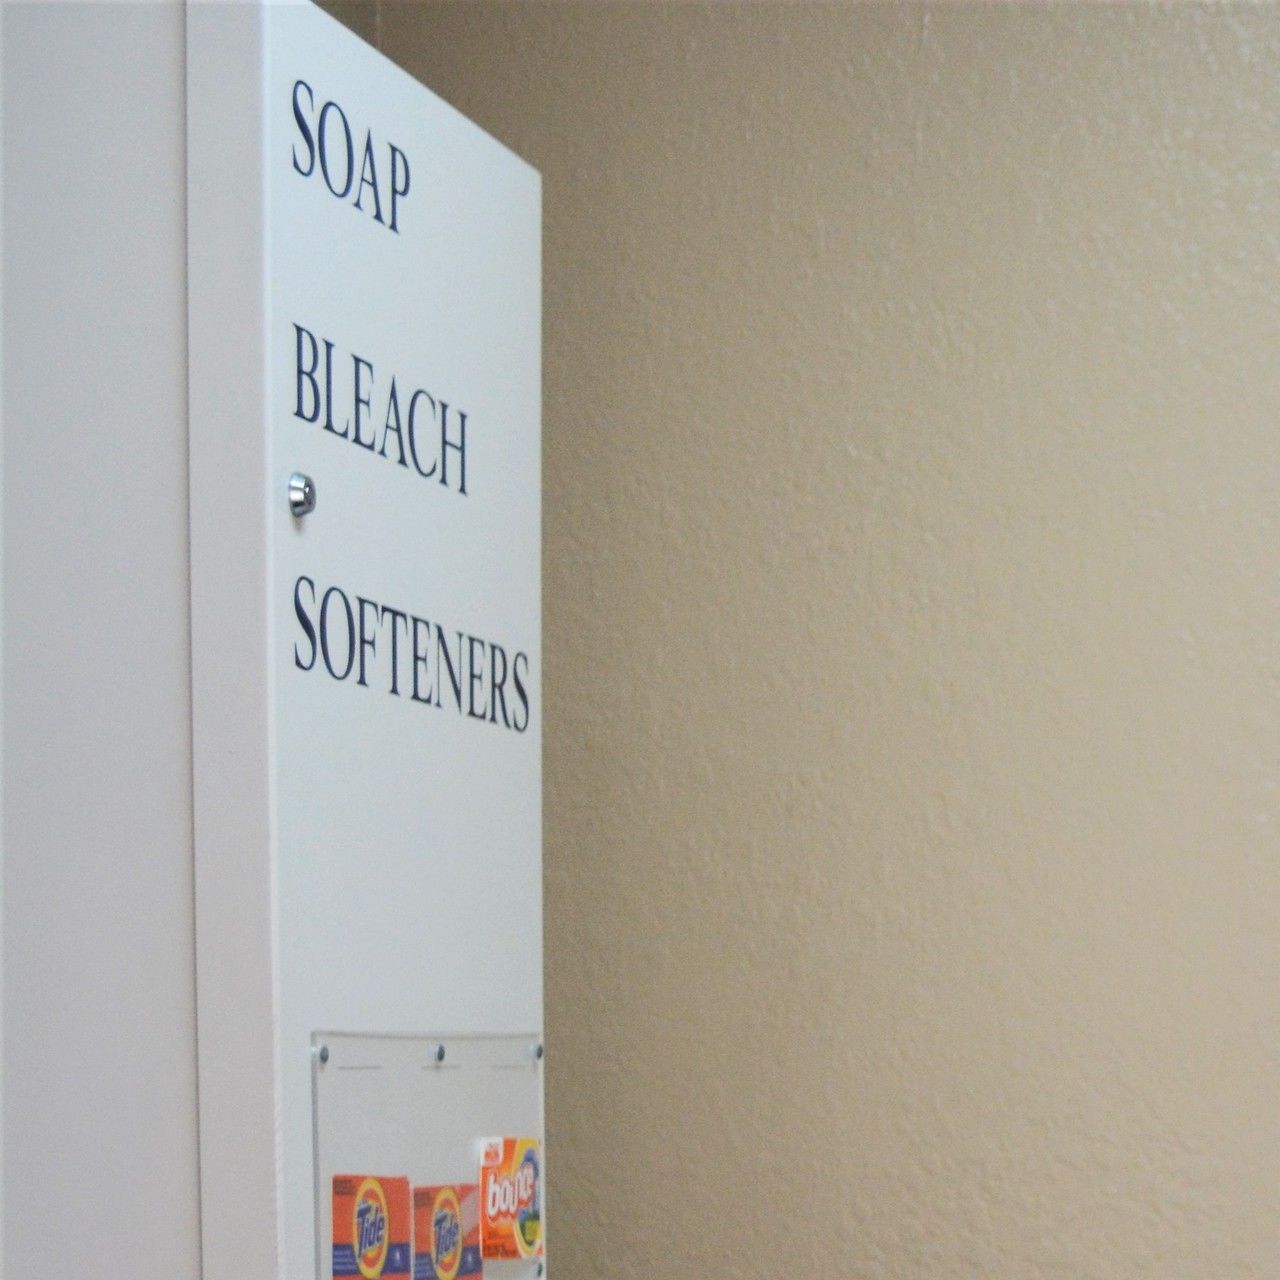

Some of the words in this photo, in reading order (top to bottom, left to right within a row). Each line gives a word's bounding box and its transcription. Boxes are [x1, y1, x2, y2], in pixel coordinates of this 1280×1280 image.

[291, 78, 411, 236] SOAP
[292, 321, 470, 497] BLEACH
[293, 575, 529, 733] SOFTENERS
[357, 1199, 386, 1259] Tide
[434, 1210, 459, 1266] Tide
